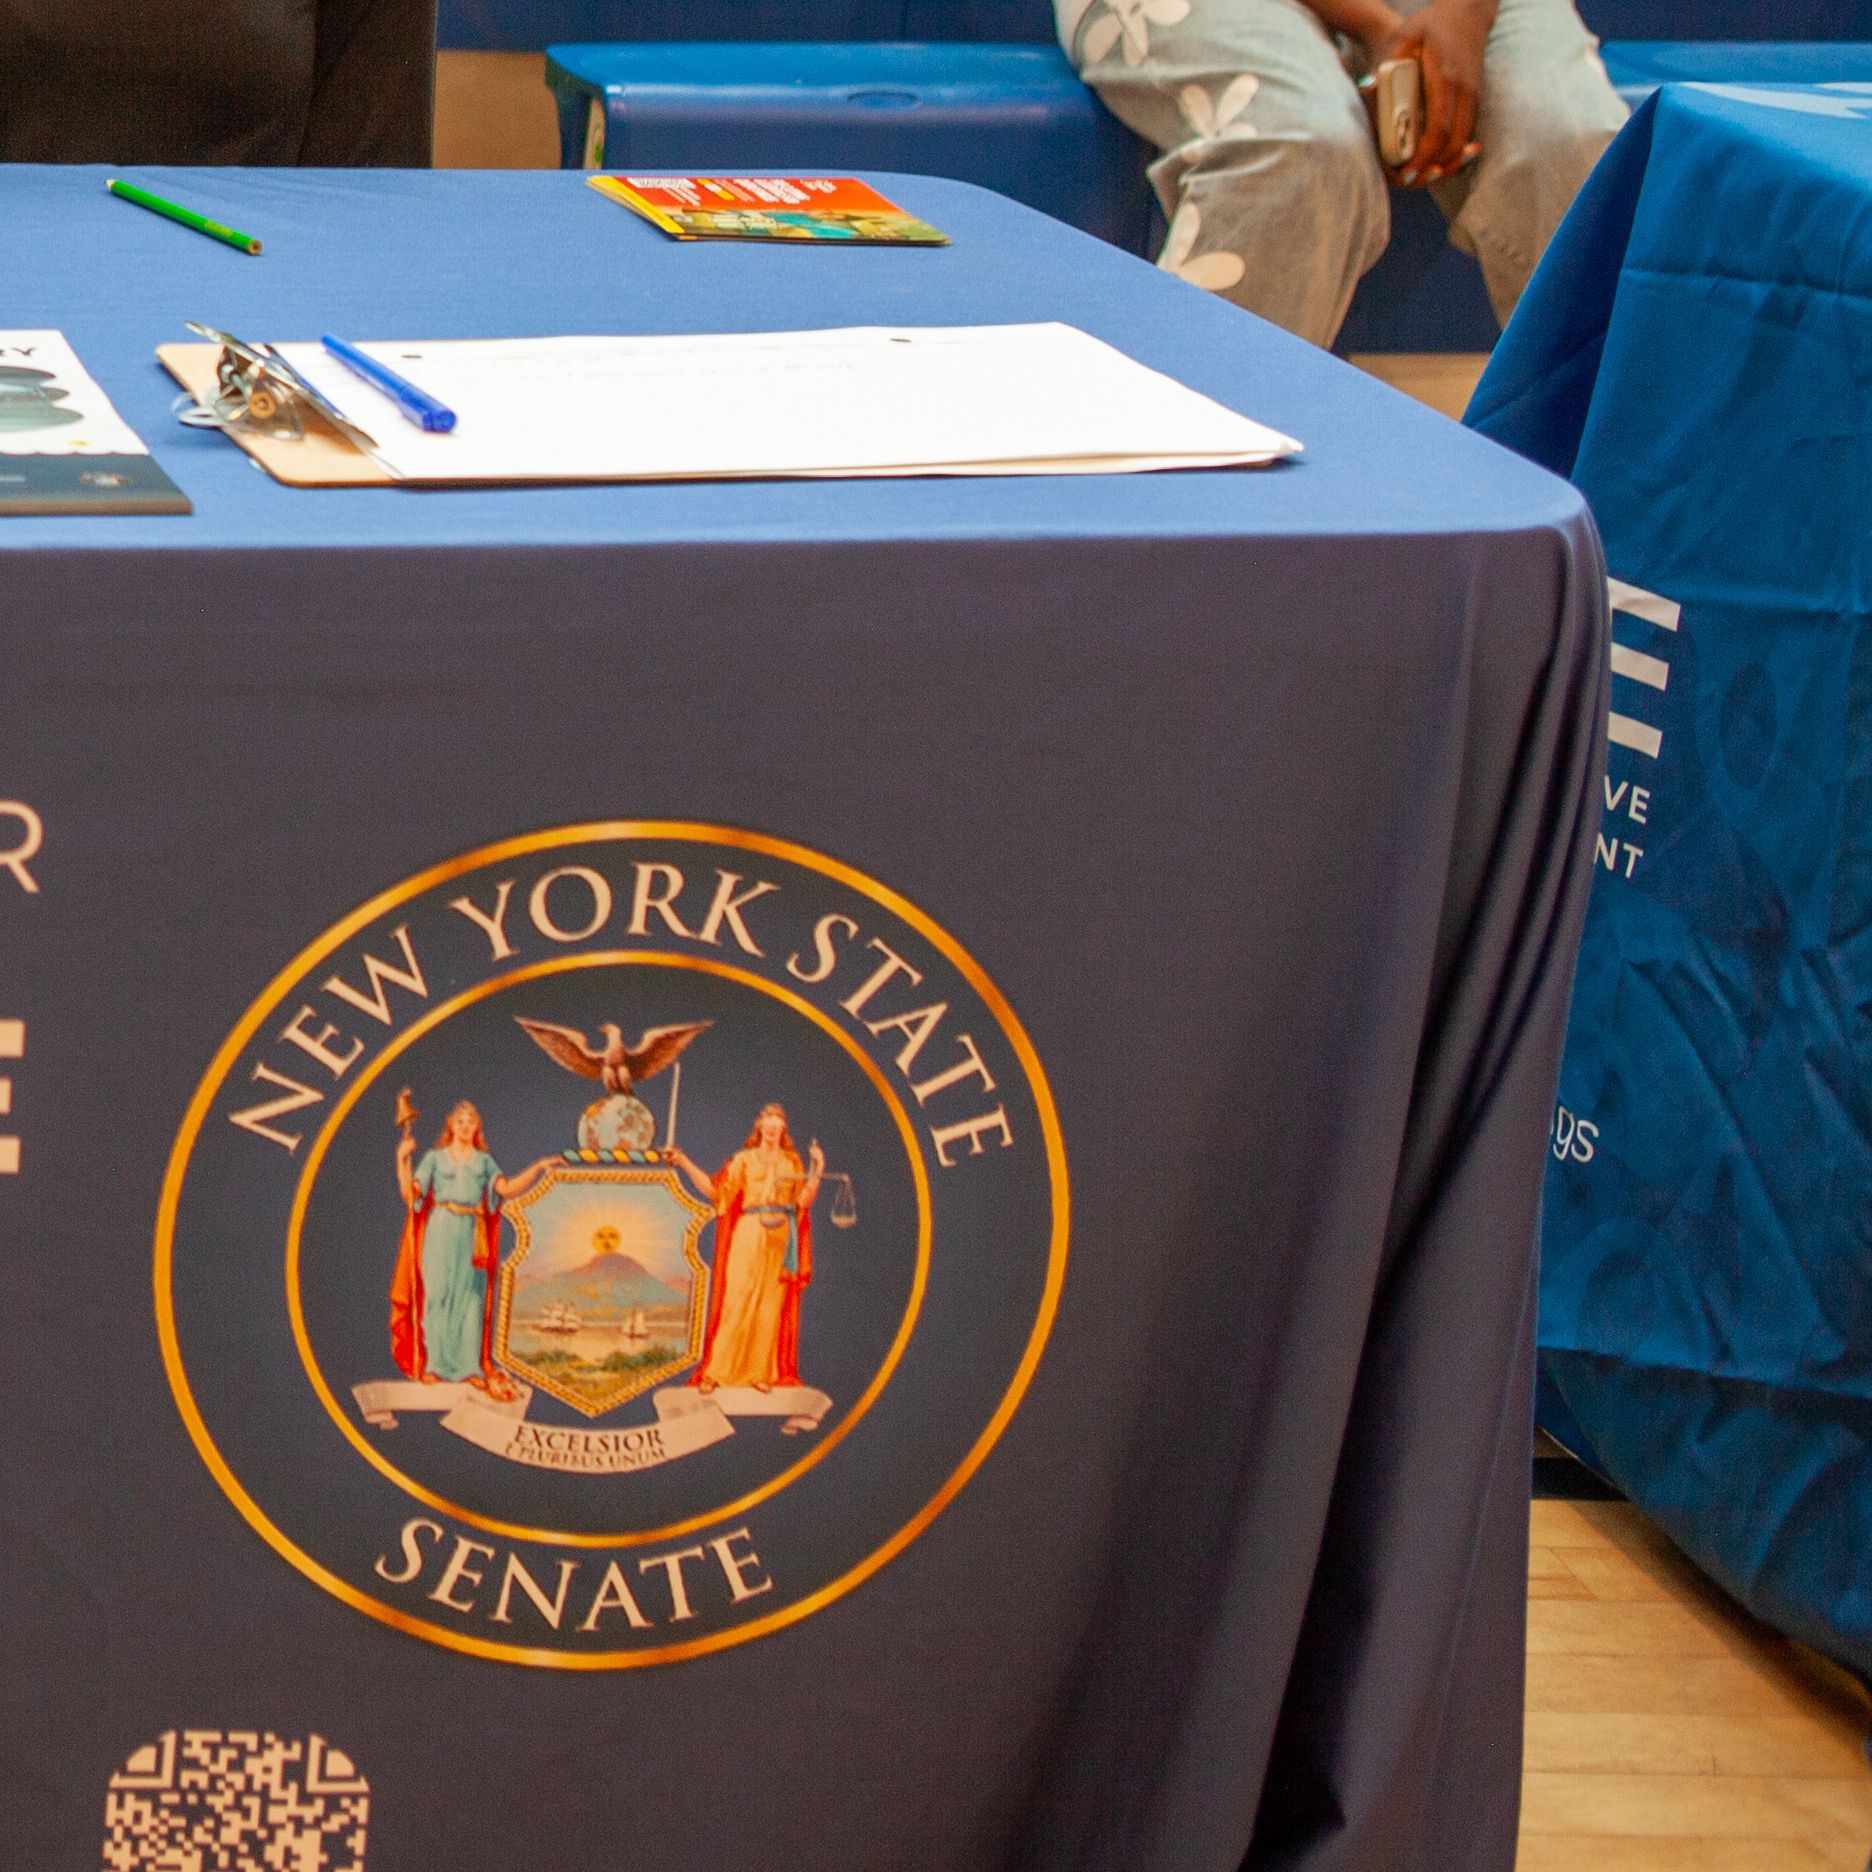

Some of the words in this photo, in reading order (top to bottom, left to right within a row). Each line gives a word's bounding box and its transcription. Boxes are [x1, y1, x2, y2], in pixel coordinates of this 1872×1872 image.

[227, 925, 430, 1155] NEW
[449, 860, 783, 964] YORK
[783, 911, 1016, 1169] STATE
[514, 1424, 665, 1454] EXCELSIOR
[519, 1446, 605, 1469] PLURIBUS
[609, 1447, 666, 1468] UNUM
[375, 1516, 775, 1632] SENATE
